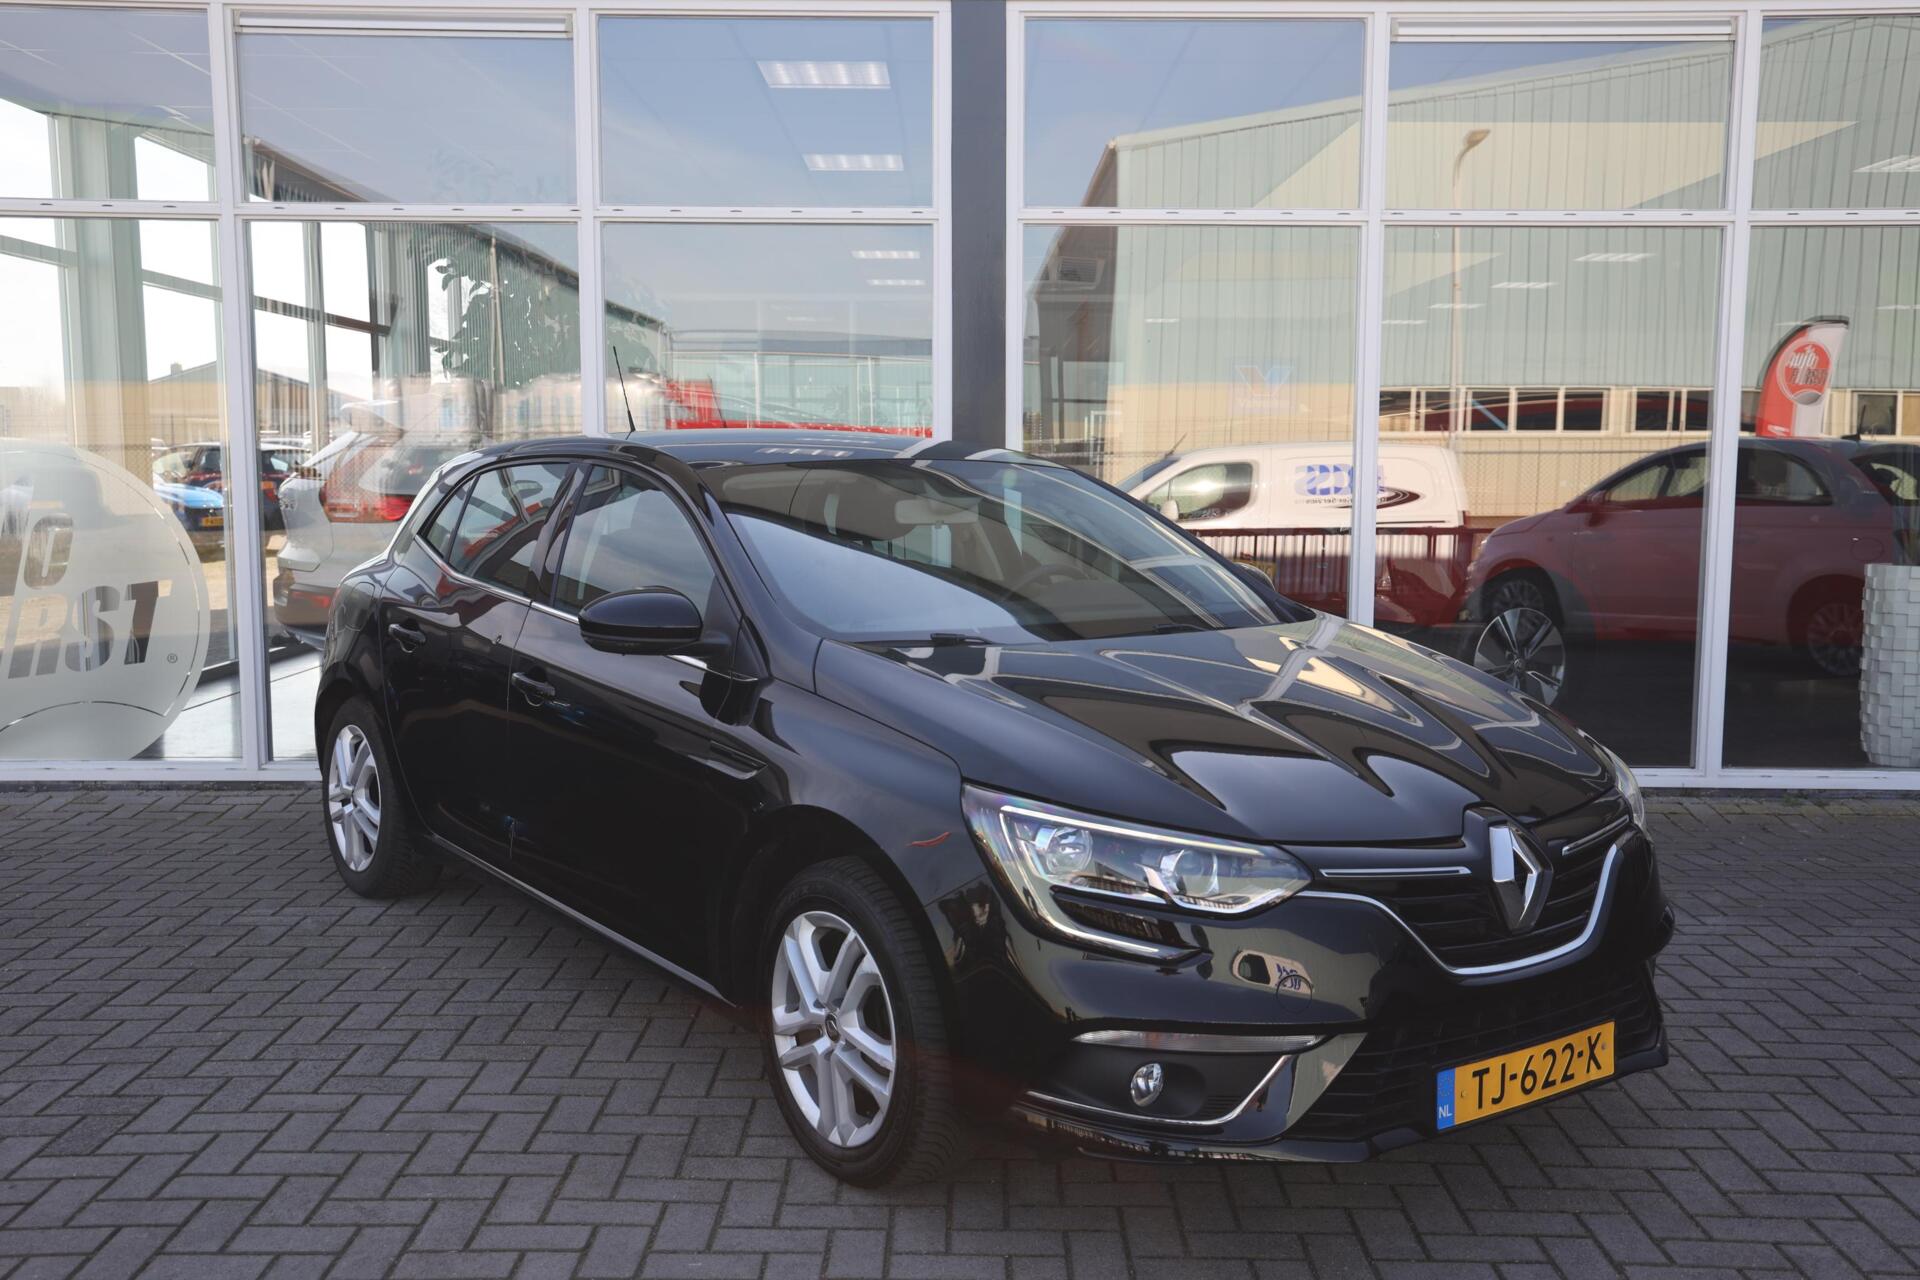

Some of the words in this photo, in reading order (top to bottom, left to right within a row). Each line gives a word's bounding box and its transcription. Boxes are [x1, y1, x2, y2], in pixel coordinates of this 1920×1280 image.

[0, 579, 173, 679] RST
[1472, 1032, 1602, 1110] TJ-622-X
[1438, 1104, 1452, 1119] NL
